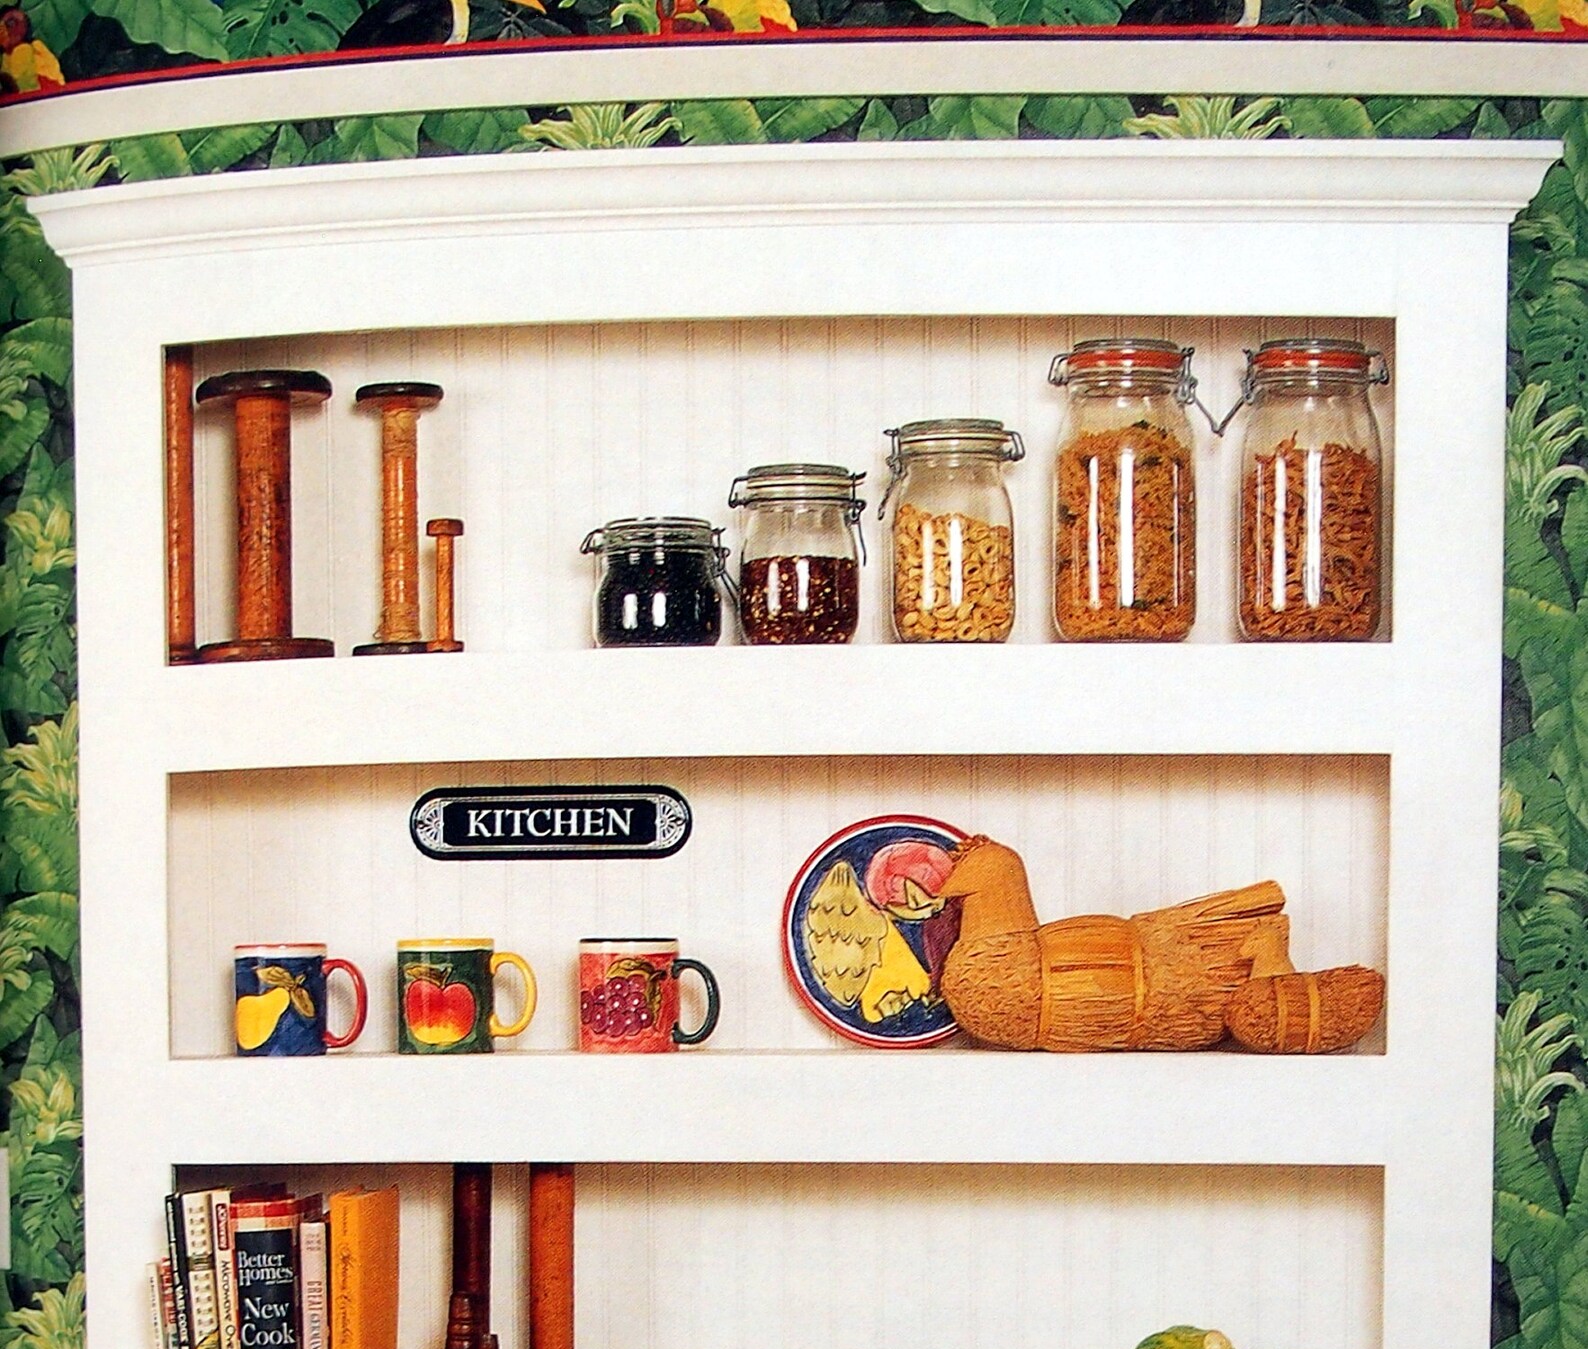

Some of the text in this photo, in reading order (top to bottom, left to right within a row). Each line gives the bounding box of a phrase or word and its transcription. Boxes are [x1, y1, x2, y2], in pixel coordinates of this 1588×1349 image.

[466, 807, 635, 838] KITCHEN
[237, 1250, 286, 1269] Better
[238, 1266, 294, 1287] Homes
[221, 1261, 233, 1321] Microwave
[306, 1280, 323, 1311] GREAT
[175, 1285, 189, 1343] VARI-COOK
[243, 1297, 290, 1321] New
[241, 1322, 296, 1347] Cook
